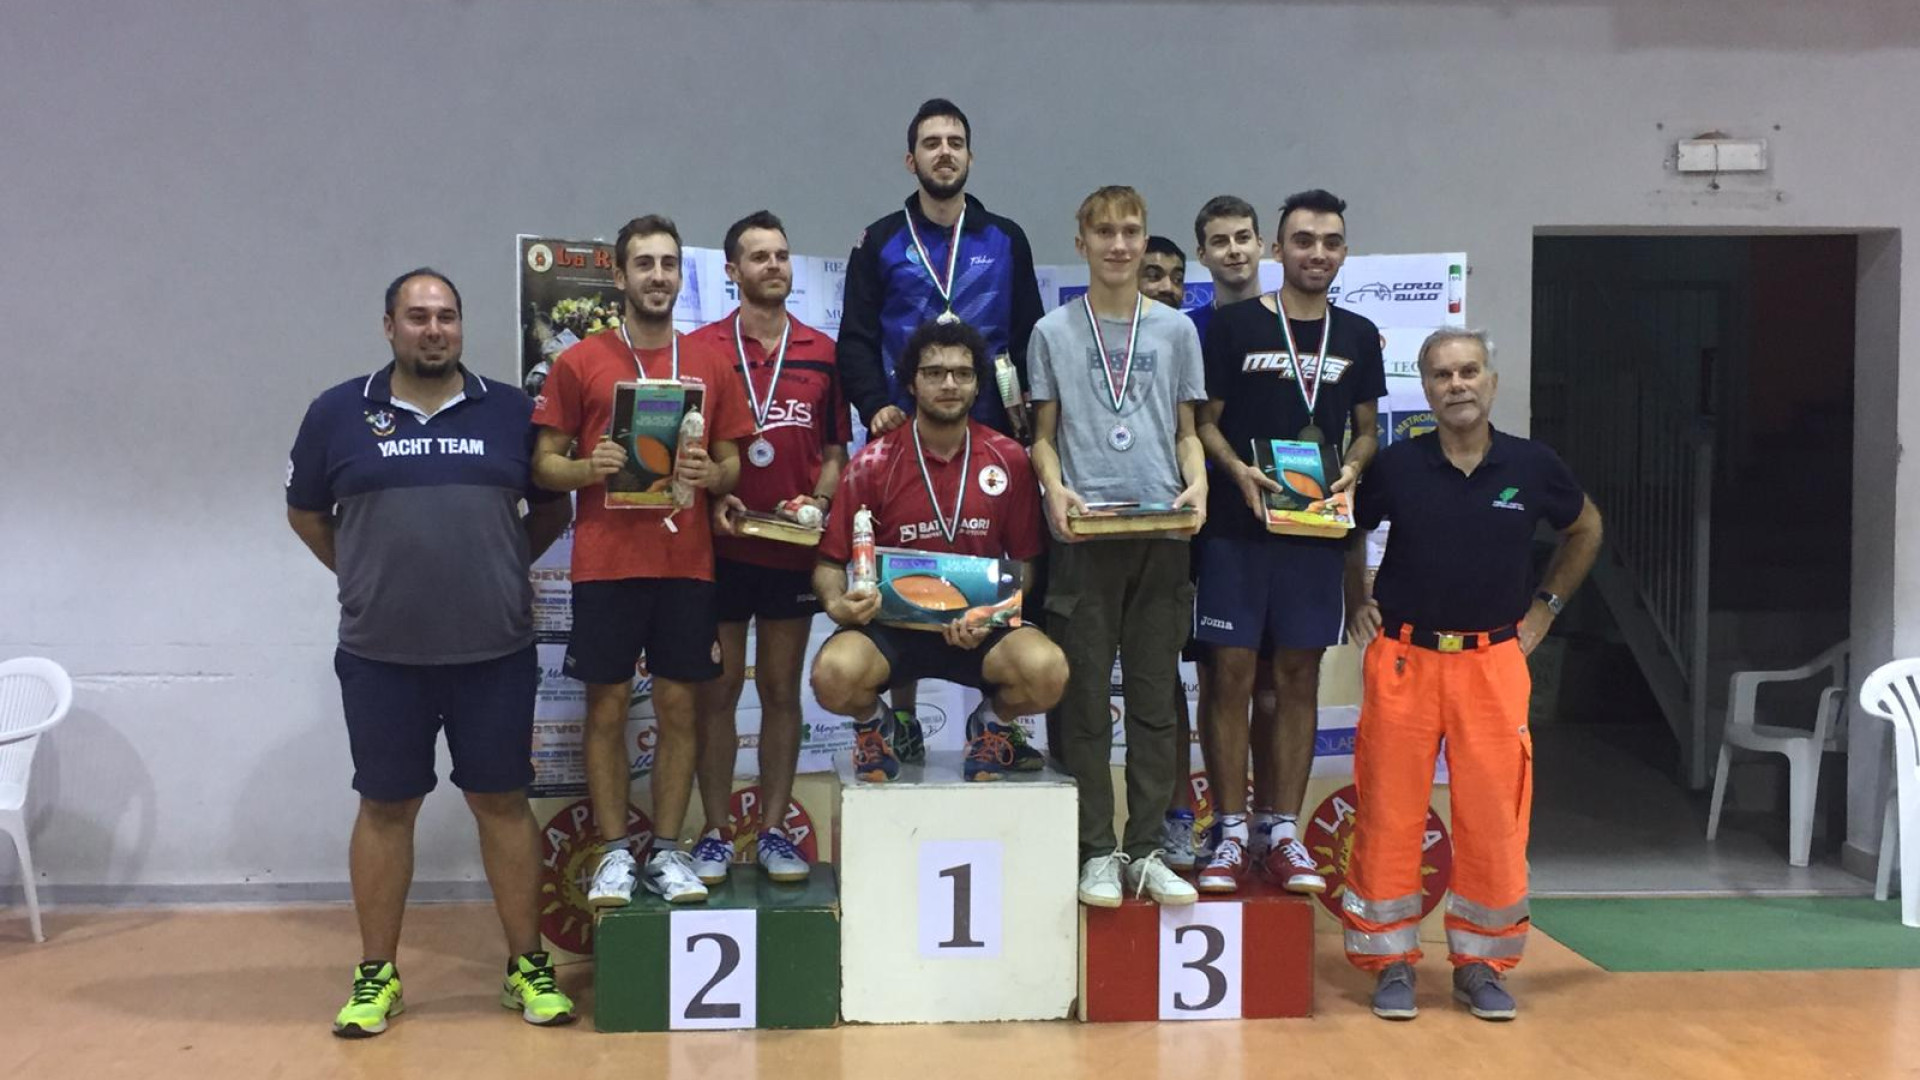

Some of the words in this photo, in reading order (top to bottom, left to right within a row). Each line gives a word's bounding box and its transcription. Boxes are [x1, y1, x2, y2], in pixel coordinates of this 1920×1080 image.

[378, 438, 433, 457] YACHT
[437, 438, 485, 456] TEAM
[1314, 796, 1356, 834] LA
[937, 862, 985, 949] 1
[684, 932, 742, 1020] 2
[1173, 924, 1228, 1011] 3
